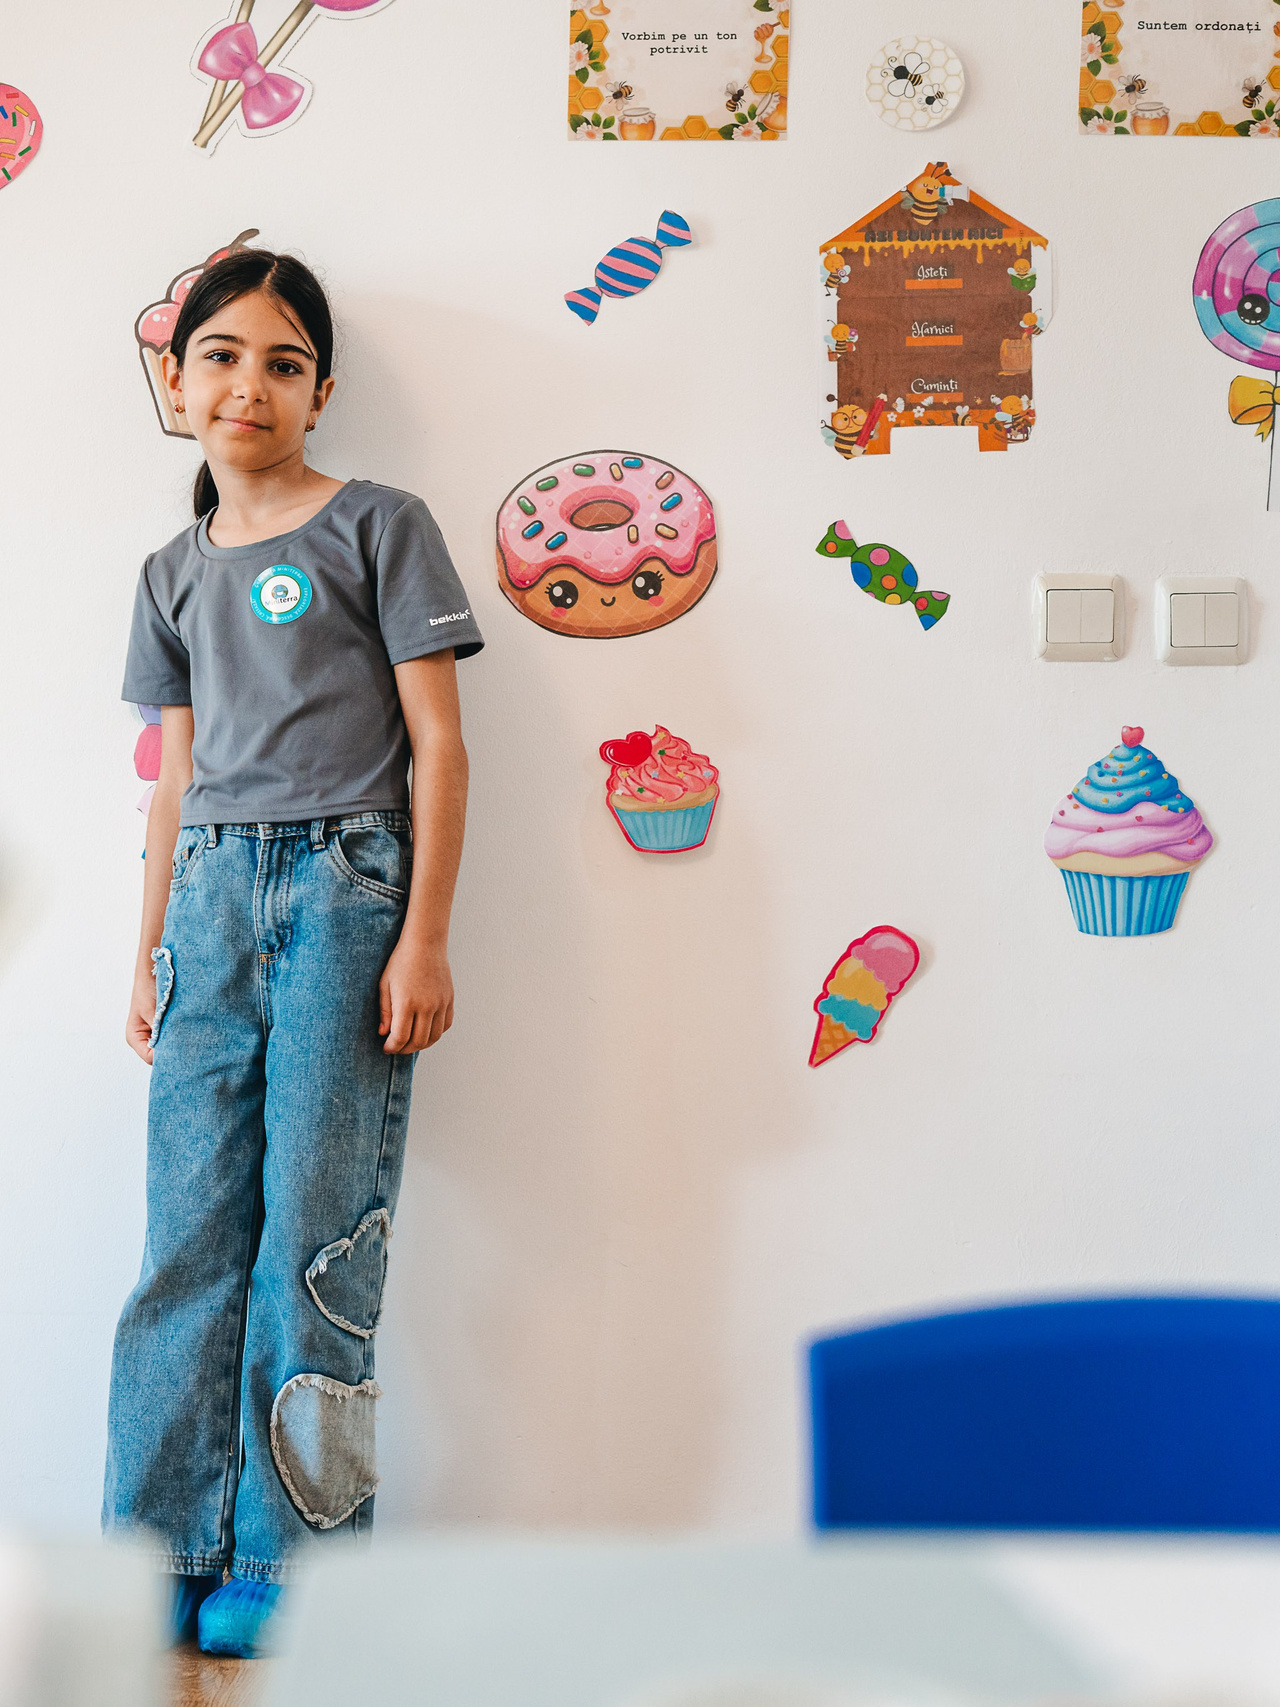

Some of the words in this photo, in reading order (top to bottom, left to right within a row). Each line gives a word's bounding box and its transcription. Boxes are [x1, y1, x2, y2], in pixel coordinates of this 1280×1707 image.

[1137, 20, 1188, 31] Suntem
[1195, 21, 1262, 34] ordonați
[621, 31, 666, 41] Vorbim
[671, 33, 687, 43] pe
[716, 31, 738, 40] ton
[649, 44, 709, 56] potrivit
[911, 321, 954, 338] Harnici
[910, 377, 958, 395] Cuminți
